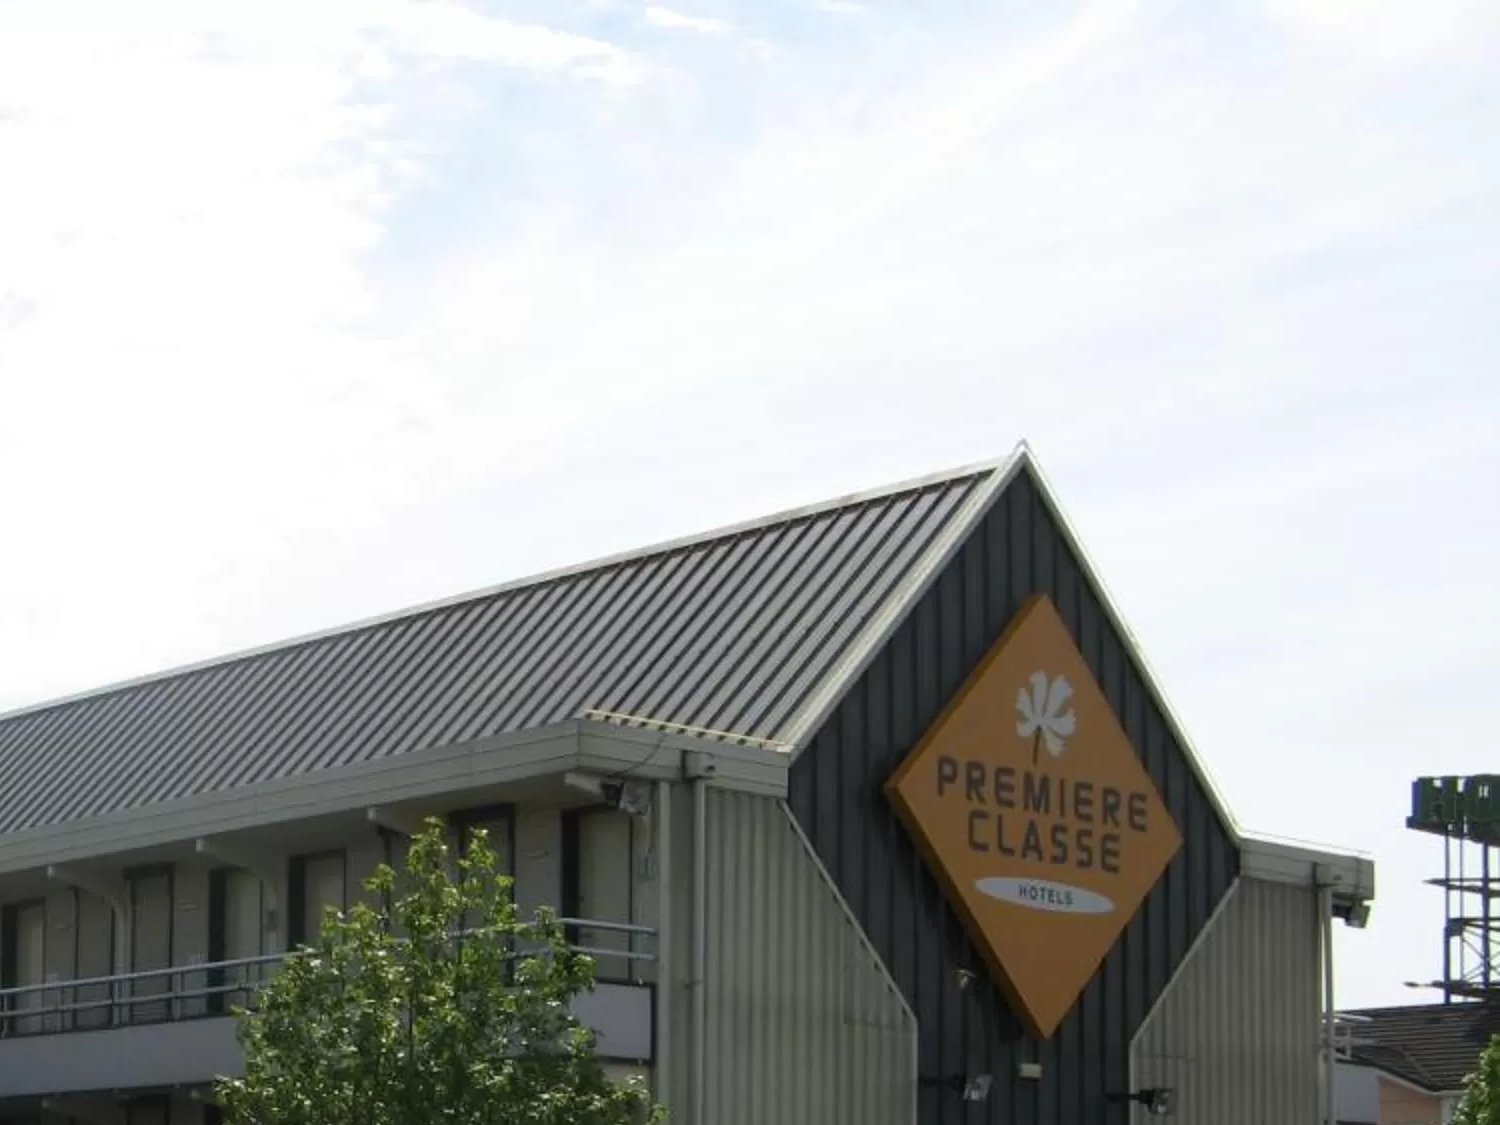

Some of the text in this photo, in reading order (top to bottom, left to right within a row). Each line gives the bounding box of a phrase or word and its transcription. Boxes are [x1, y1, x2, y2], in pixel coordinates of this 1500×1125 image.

[936, 755, 1149, 833] PREMIERE
[968, 809, 1121, 875] CLASSE
[1018, 884, 1074, 906] HOTELS
